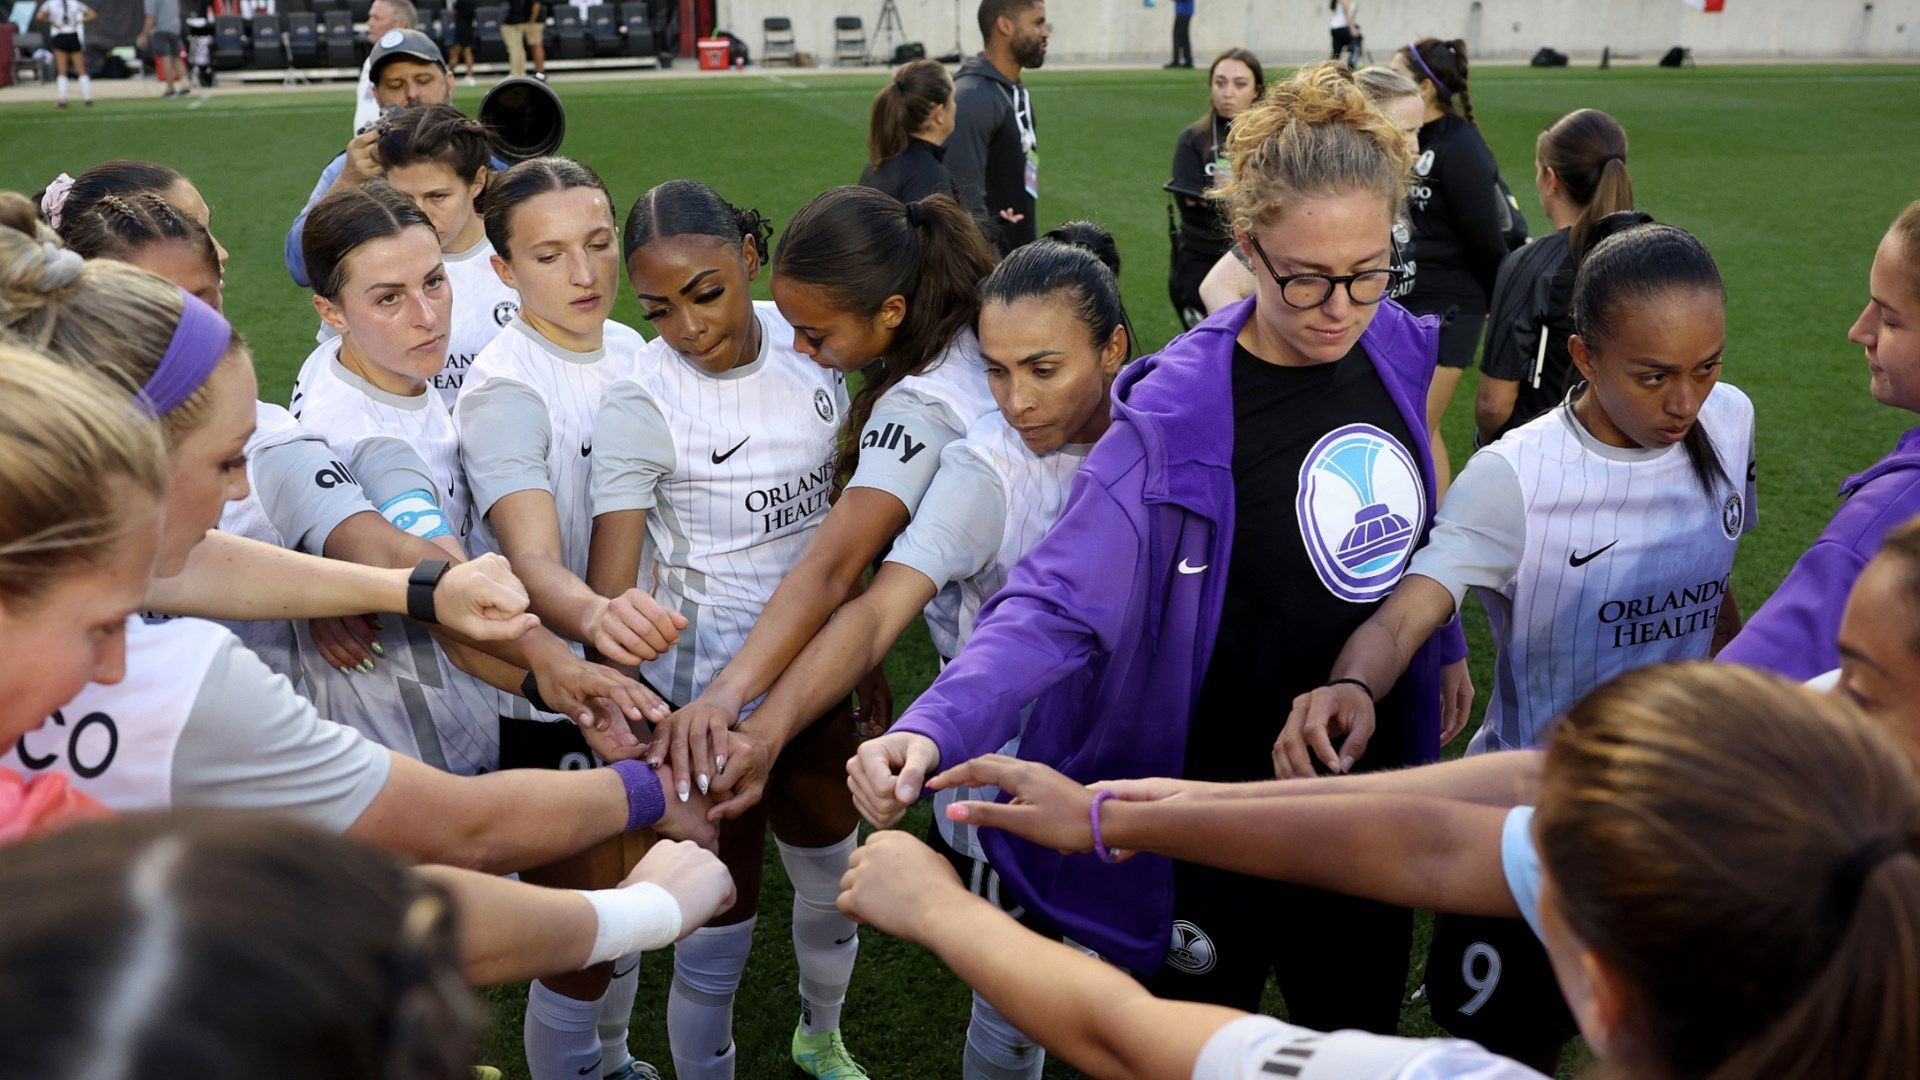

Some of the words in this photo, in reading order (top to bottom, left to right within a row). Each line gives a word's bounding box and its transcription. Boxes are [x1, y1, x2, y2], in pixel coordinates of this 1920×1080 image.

[861, 422, 926, 464] ally
[315, 460, 358, 489] all
[763, 486, 830, 534] HEALT
[1458, 941, 1502, 1016] 9
